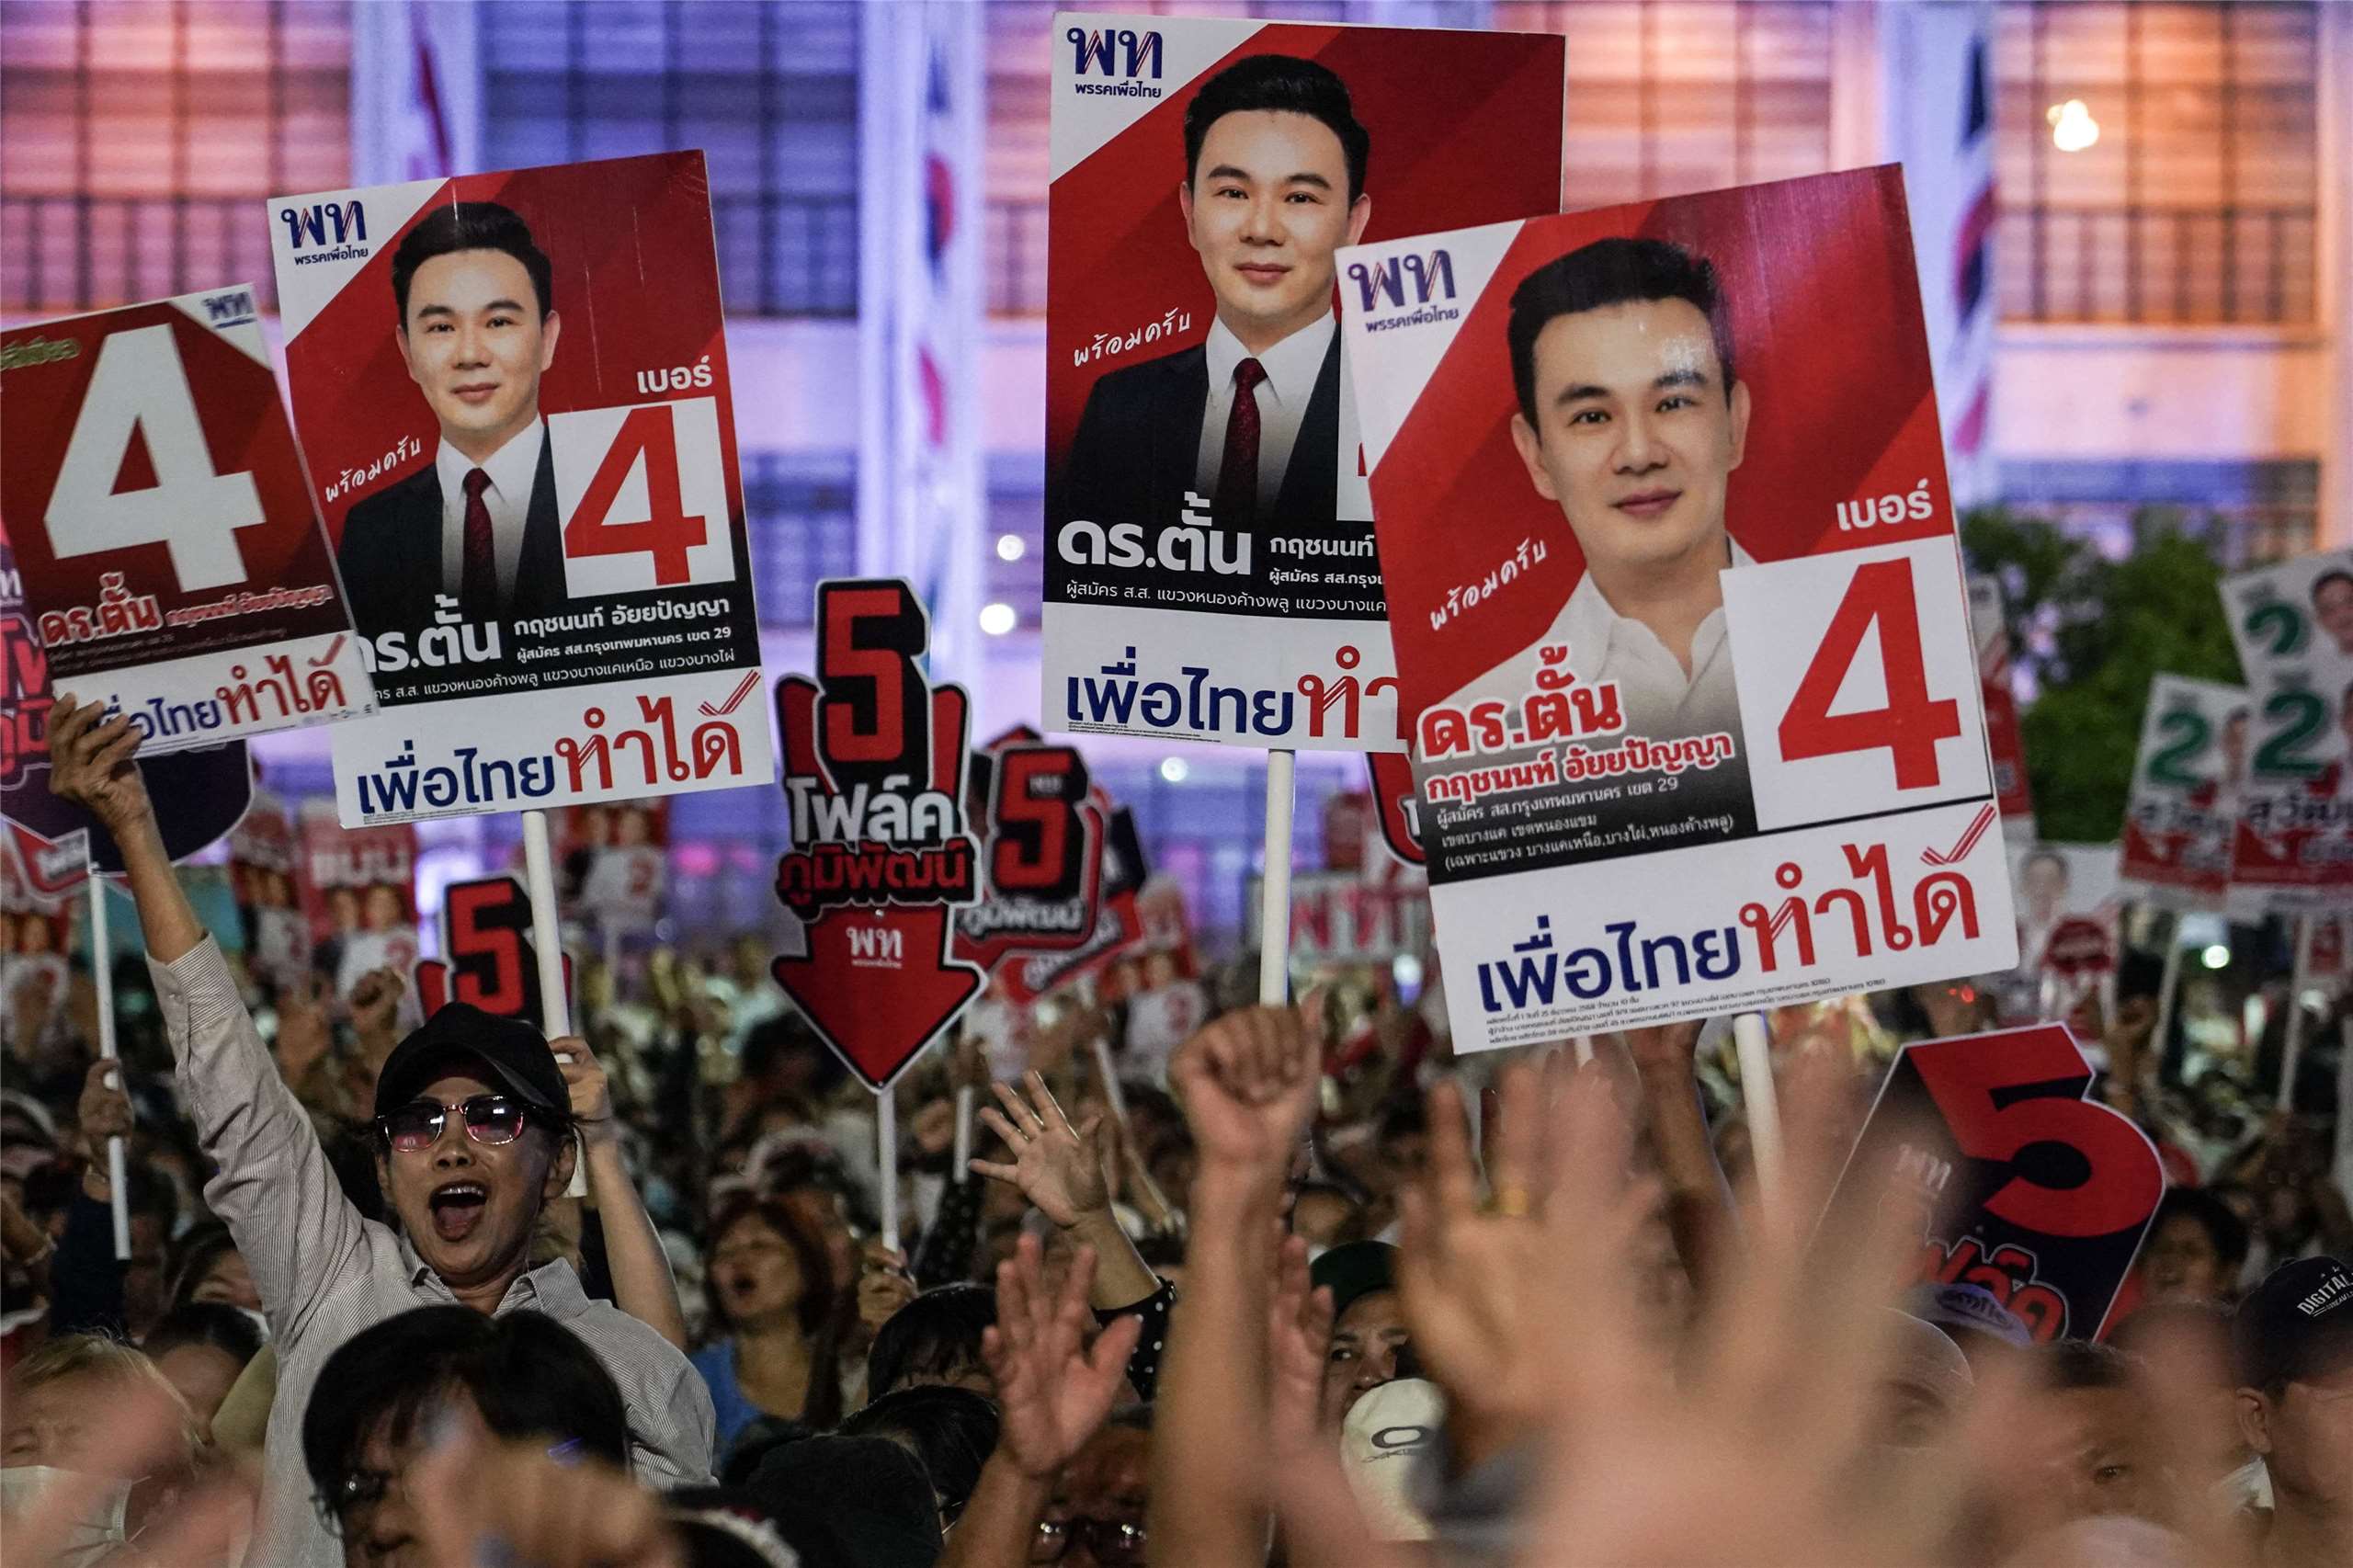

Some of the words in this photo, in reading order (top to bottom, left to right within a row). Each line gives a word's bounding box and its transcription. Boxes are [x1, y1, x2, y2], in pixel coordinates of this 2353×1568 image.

[1075, 80, 1161, 98] พรรคเพื่อไทย
[294, 247, 369, 266] พรรคเพื่อไทย
[1074, 306, 1192, 367] พร้อมครับ
[1366, 305, 1460, 333] พรรคเพื่อไทย
[636, 355, 713, 394] เบอร์
[43, 323, 267, 593] 4
[324, 436, 422, 505] พร้อมครับ
[563, 404, 708, 586] 4
[1836, 477, 1933, 531] เบอร์
[1057, 491, 1252, 576] ดร.ตั้น
[1269, 534, 1375, 560] กฤชนนท์
[1066, 579, 1118, 598] ผู้สมัคร
[1124, 586, 1151, 599] ส.ส.
[1157, 589, 1290, 613] แขวงหนองค้างพลู
[1269, 567, 1319, 585] ผู้สมัคร
[1430, 535, 1548, 631] พร้อมครับ
[514, 607, 604, 639] กฤชนนท์
[612, 598, 730, 627] อัยยปัญญา
[517, 646, 561, 665] ผู้สมัคร
[565, 634, 683, 655] สส.กรุงเทพมหานคร
[687, 630, 710, 642] เขต
[713, 627, 733, 640] 29
[103, 634, 347, 742] ื่อไทยทำได้
[395, 687, 420, 700] ส.ส.
[424, 670, 539, 697] แขวงหนองค้างพลู
[543, 658, 654, 683] แขวงบางแคเหนือ
[659, 647, 735, 670] แขวงบางไผ่
[826, 587, 904, 762] 5
[1419, 644, 1624, 761] ดร.ตั้น
[1778, 557, 1961, 790] 4
[358, 668, 762, 816] เพื่อไทยทำได้
[2145, 711, 2210, 787] 2
[2253, 693, 2327, 775] 2
[1426, 750, 1558, 806] กฤชนนท์
[1565, 732, 1735, 782] อัยยปัญญา
[786, 775, 954, 843] โฟล์ค
[994, 749, 1074, 889] 5
[1436, 803, 1484, 833] ผู้สมัคร
[1626, 781, 1654, 797] เขต
[1657, 777, 1679, 792] 29
[782, 837, 967, 906] ภูมิพัฒน์
[1477, 802, 1997, 1014] เพื่อไทยทำได้
[449, 881, 525, 1016] 5
[1906, 1022, 2165, 1238] 5
[2297, 1274, 2353, 1315] DIGITAL
